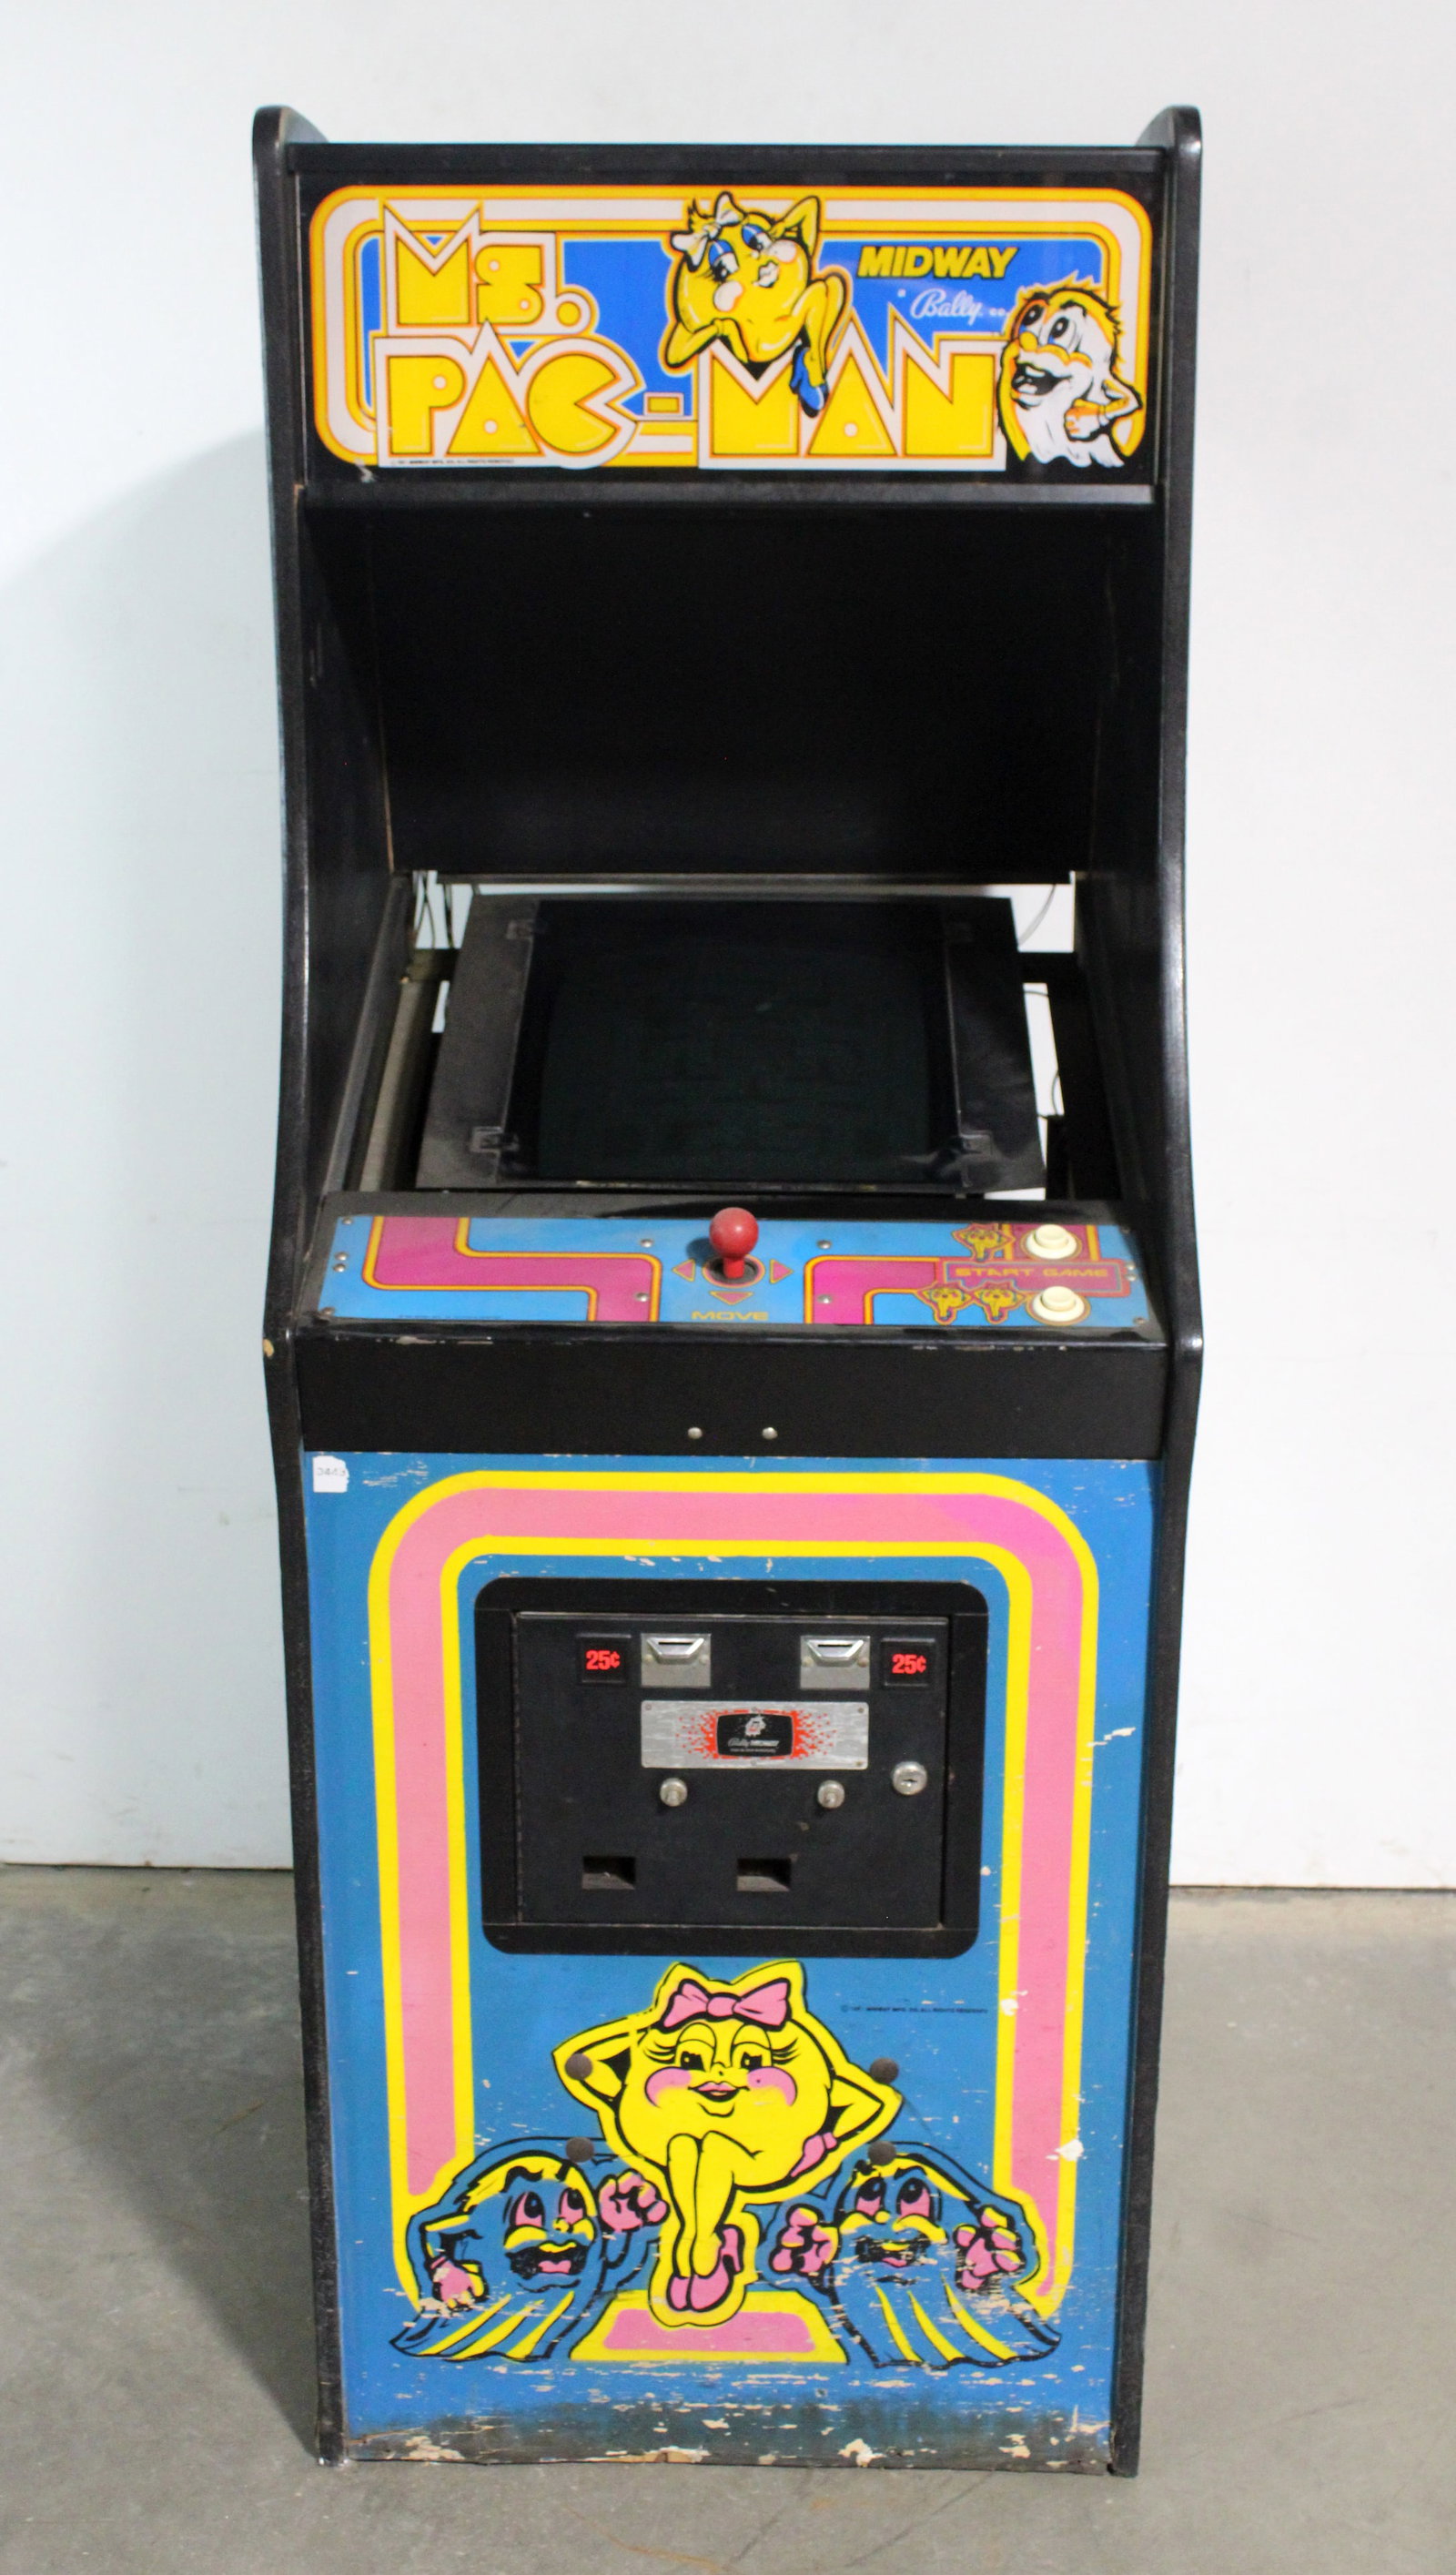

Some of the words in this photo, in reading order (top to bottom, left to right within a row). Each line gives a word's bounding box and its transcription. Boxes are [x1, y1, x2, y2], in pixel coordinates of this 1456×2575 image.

[857, 245, 1018, 279] MIDWAY
[910, 288, 983, 326] Bally
[377, 326, 1006, 467] PAC-MAN
[956, 1267, 1034, 1277] START
[1043, 1267, 1108, 1278] GAME
[691, 1311, 769, 1321] MOVE
[585, 1649, 621, 1670] 25¢
[892, 1653, 927, 1675] 25¢
